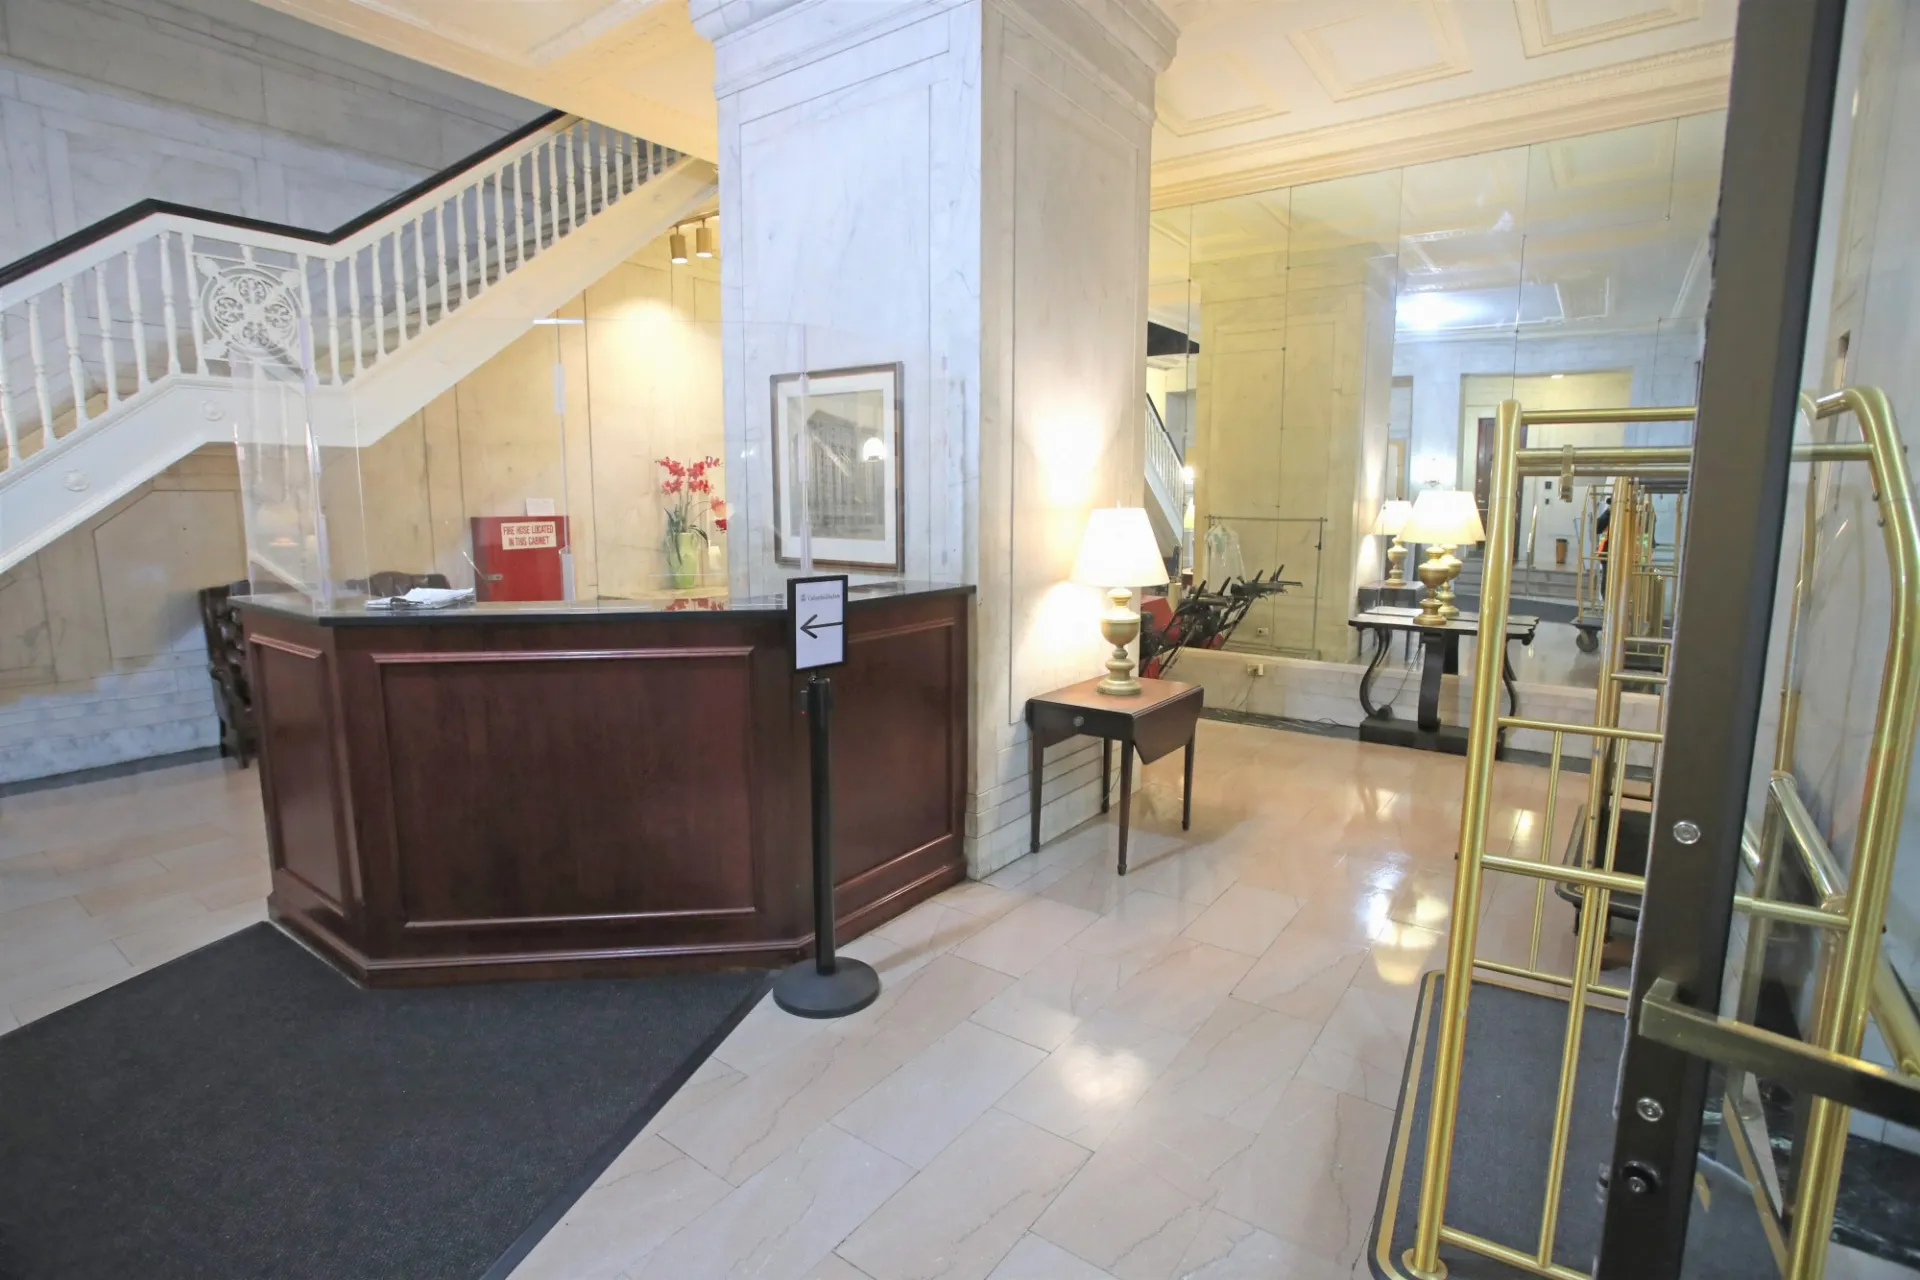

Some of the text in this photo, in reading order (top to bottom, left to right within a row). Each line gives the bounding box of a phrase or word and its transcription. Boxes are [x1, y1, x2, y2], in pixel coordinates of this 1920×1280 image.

[503, 524, 554, 535] FIRE HOSE LOCATED
[515, 537, 527, 546] THIS
[528, 535, 549, 545] CABINET
